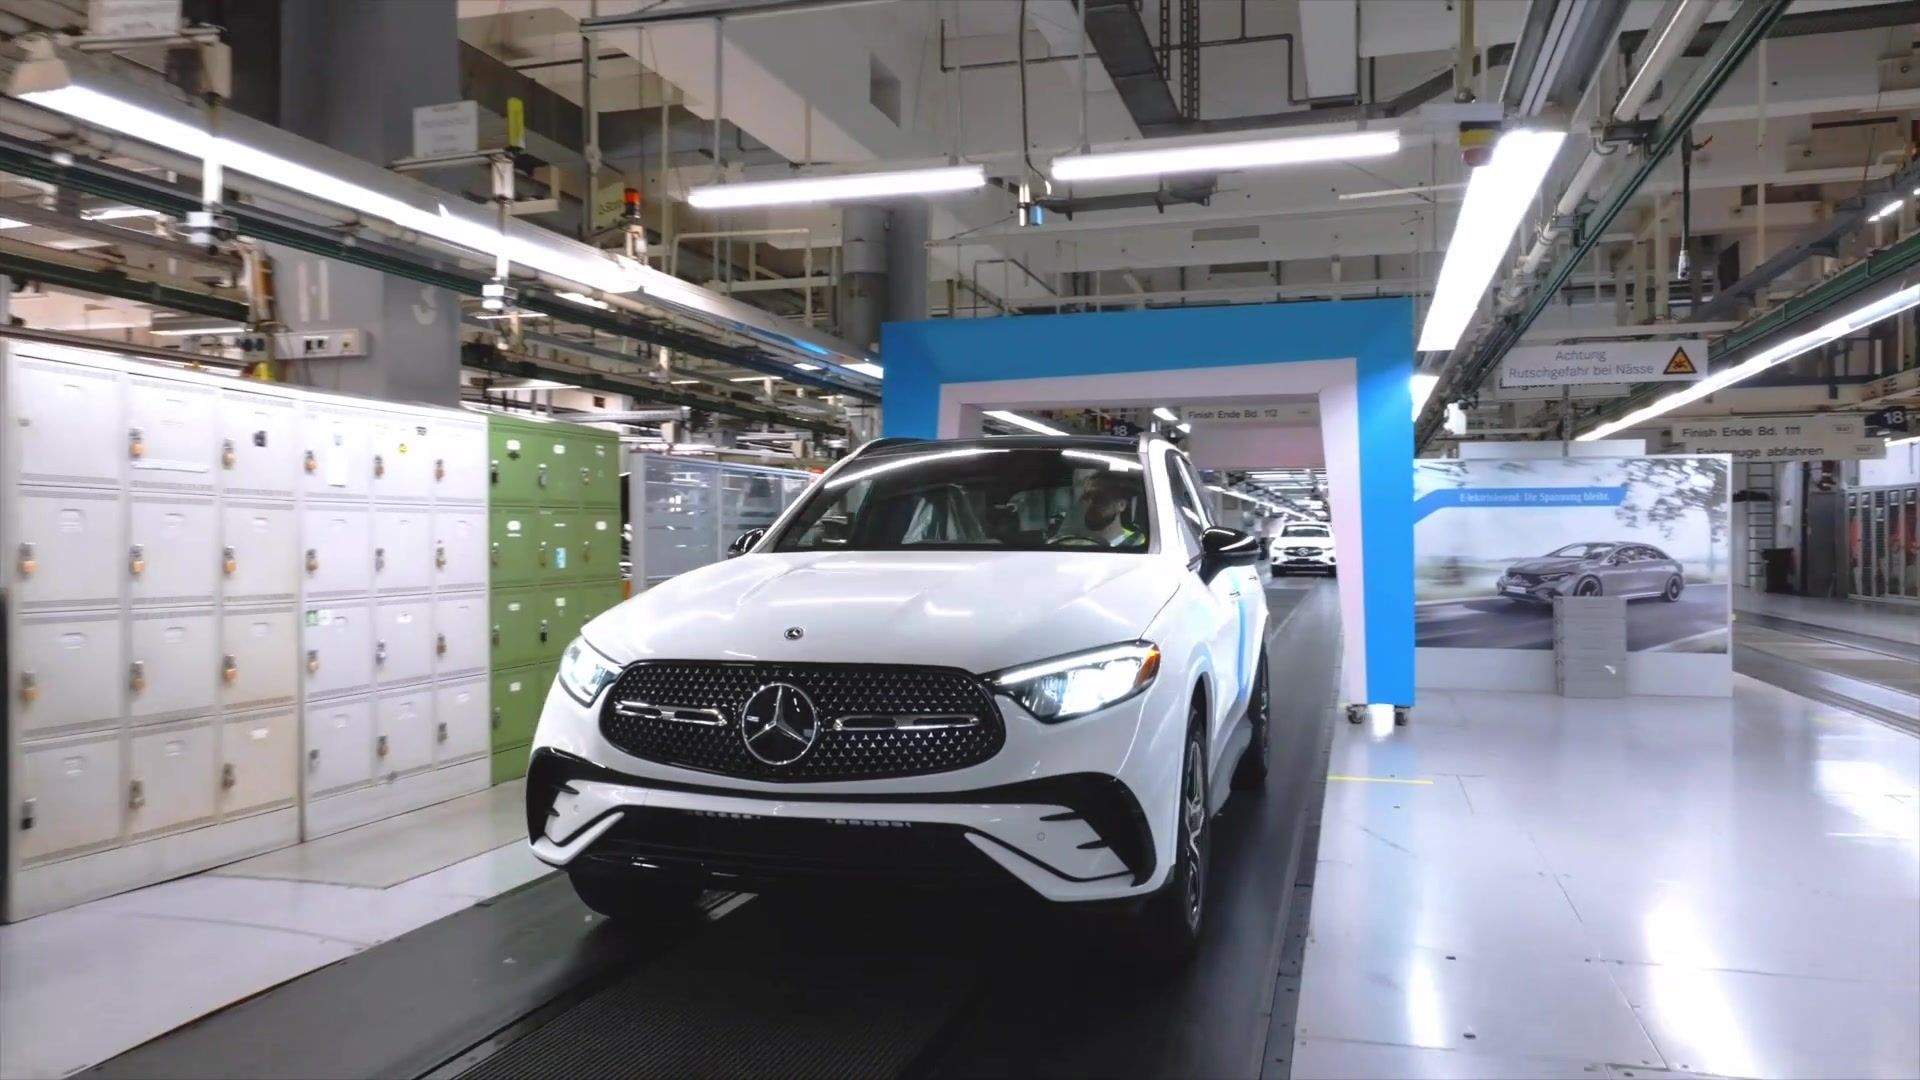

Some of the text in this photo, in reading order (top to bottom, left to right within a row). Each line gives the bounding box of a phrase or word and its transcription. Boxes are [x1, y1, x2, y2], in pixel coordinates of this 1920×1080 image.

[1555, 350, 1608, 362] Achtung
[1508, 363, 1654, 380] Rutschgefahr bei Nässe
[1188, 411, 1214, 419] Finish
[1218, 410, 1241, 418] Ende
[1883, 410, 1904, 424] 18
[1682, 427, 1717, 438] Finish
[1722, 426, 1752, 437] Ende
[1766, 446, 1824, 457] abfahren
